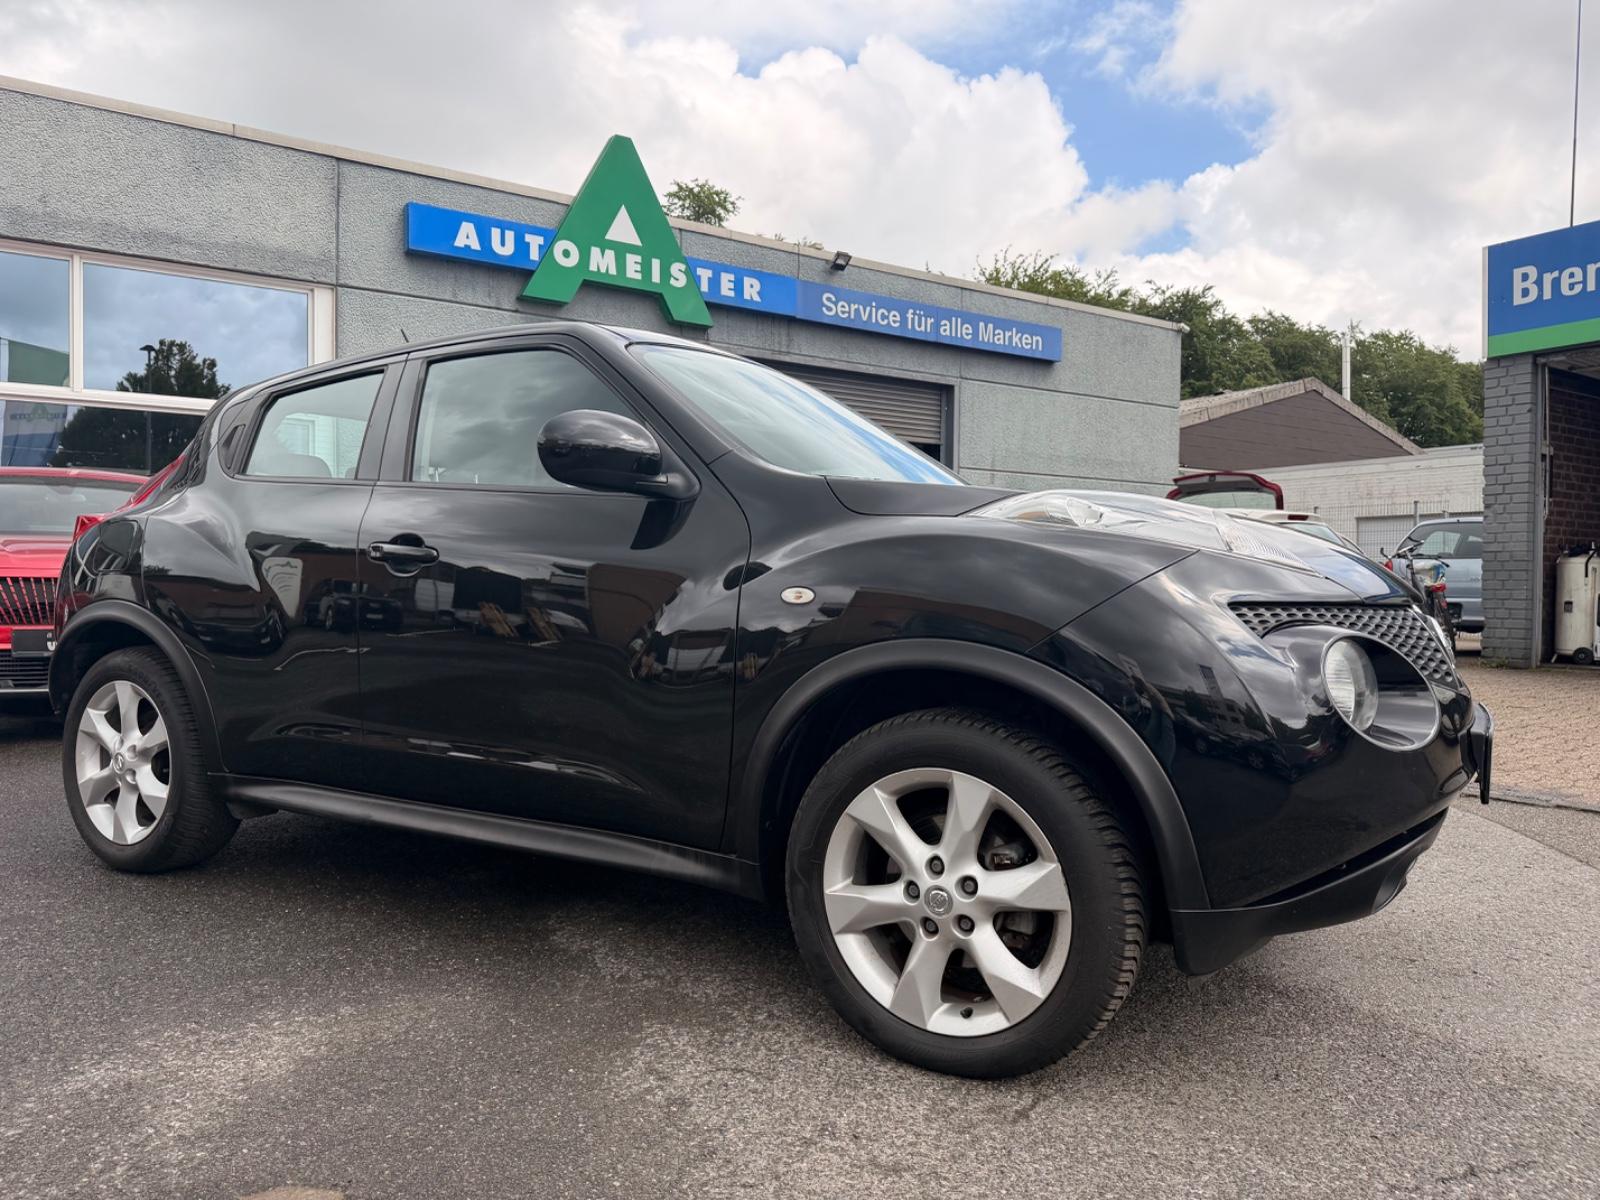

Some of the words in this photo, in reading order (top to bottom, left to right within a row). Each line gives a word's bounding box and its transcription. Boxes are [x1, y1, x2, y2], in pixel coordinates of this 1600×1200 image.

[453, 221, 762, 303] AUTOMEISTER
[822, 292, 901, 328] Service
[906, 308, 935, 333] für
[940, 317, 973, 340] alle
[979, 321, 1043, 351] Marken
